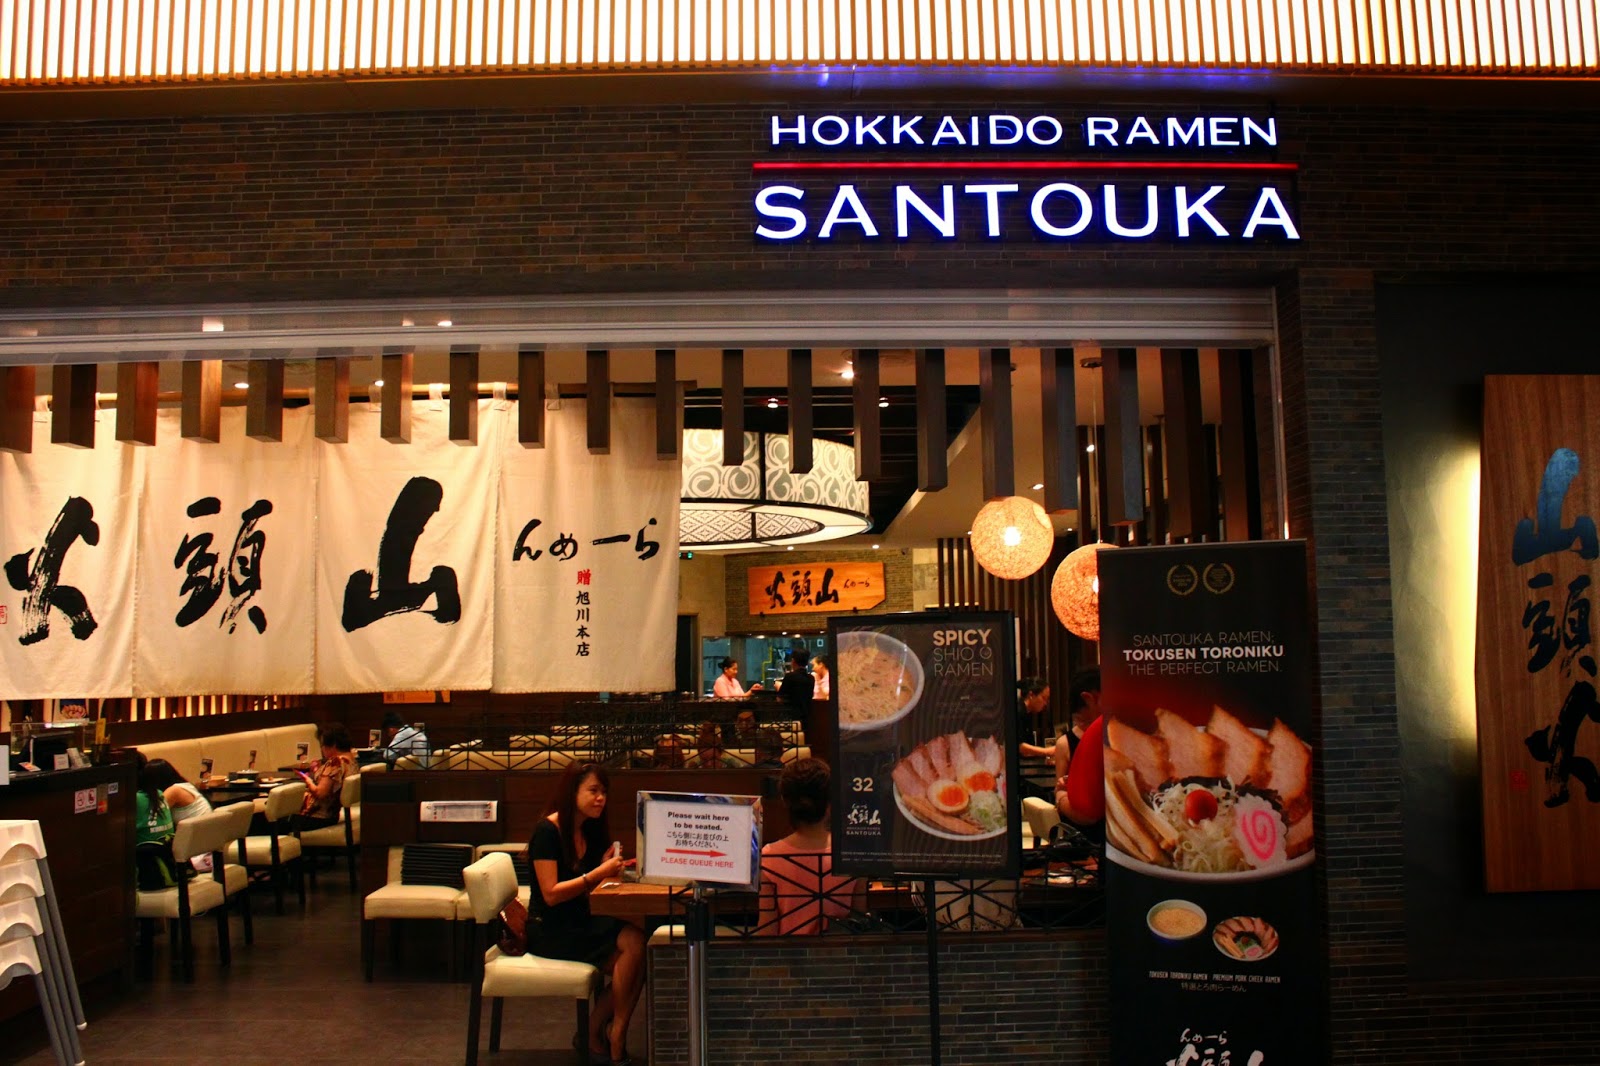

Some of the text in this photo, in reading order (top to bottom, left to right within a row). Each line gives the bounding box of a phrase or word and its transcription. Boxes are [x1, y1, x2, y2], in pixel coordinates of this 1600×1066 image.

[770, 114, 1278, 147] HOKKAIDO RAMEN
[753, 181, 1301, 240] SANTOUKA
[932, 628, 992, 647] SPICY
[1132, 632, 1214, 648] SANTOUKA
[932, 646, 975, 662] SHIO
[1122, 647, 1197, 662] TOKUSEN
[934, 662, 994, 677] RAMEN
[1128, 662, 1155, 676] THE
[1159, 660, 1221, 675] PERFECT
[852, 777, 874, 792] 32
[667, 811, 730, 822] Please wait here
[683, 822, 693, 830] be
[694, 823, 723, 831] seated.
[660, 856, 734, 868] PLEASE QUEUE HERE
[1193, 972, 1208, 980] RAMEN
[1212, 973, 1234, 982] PREMIUM
[1235, 974, 1247, 982] PORK
[1248, 975, 1263, 983] CHEEK
[1264, 975, 1281, 983] RAMEN
